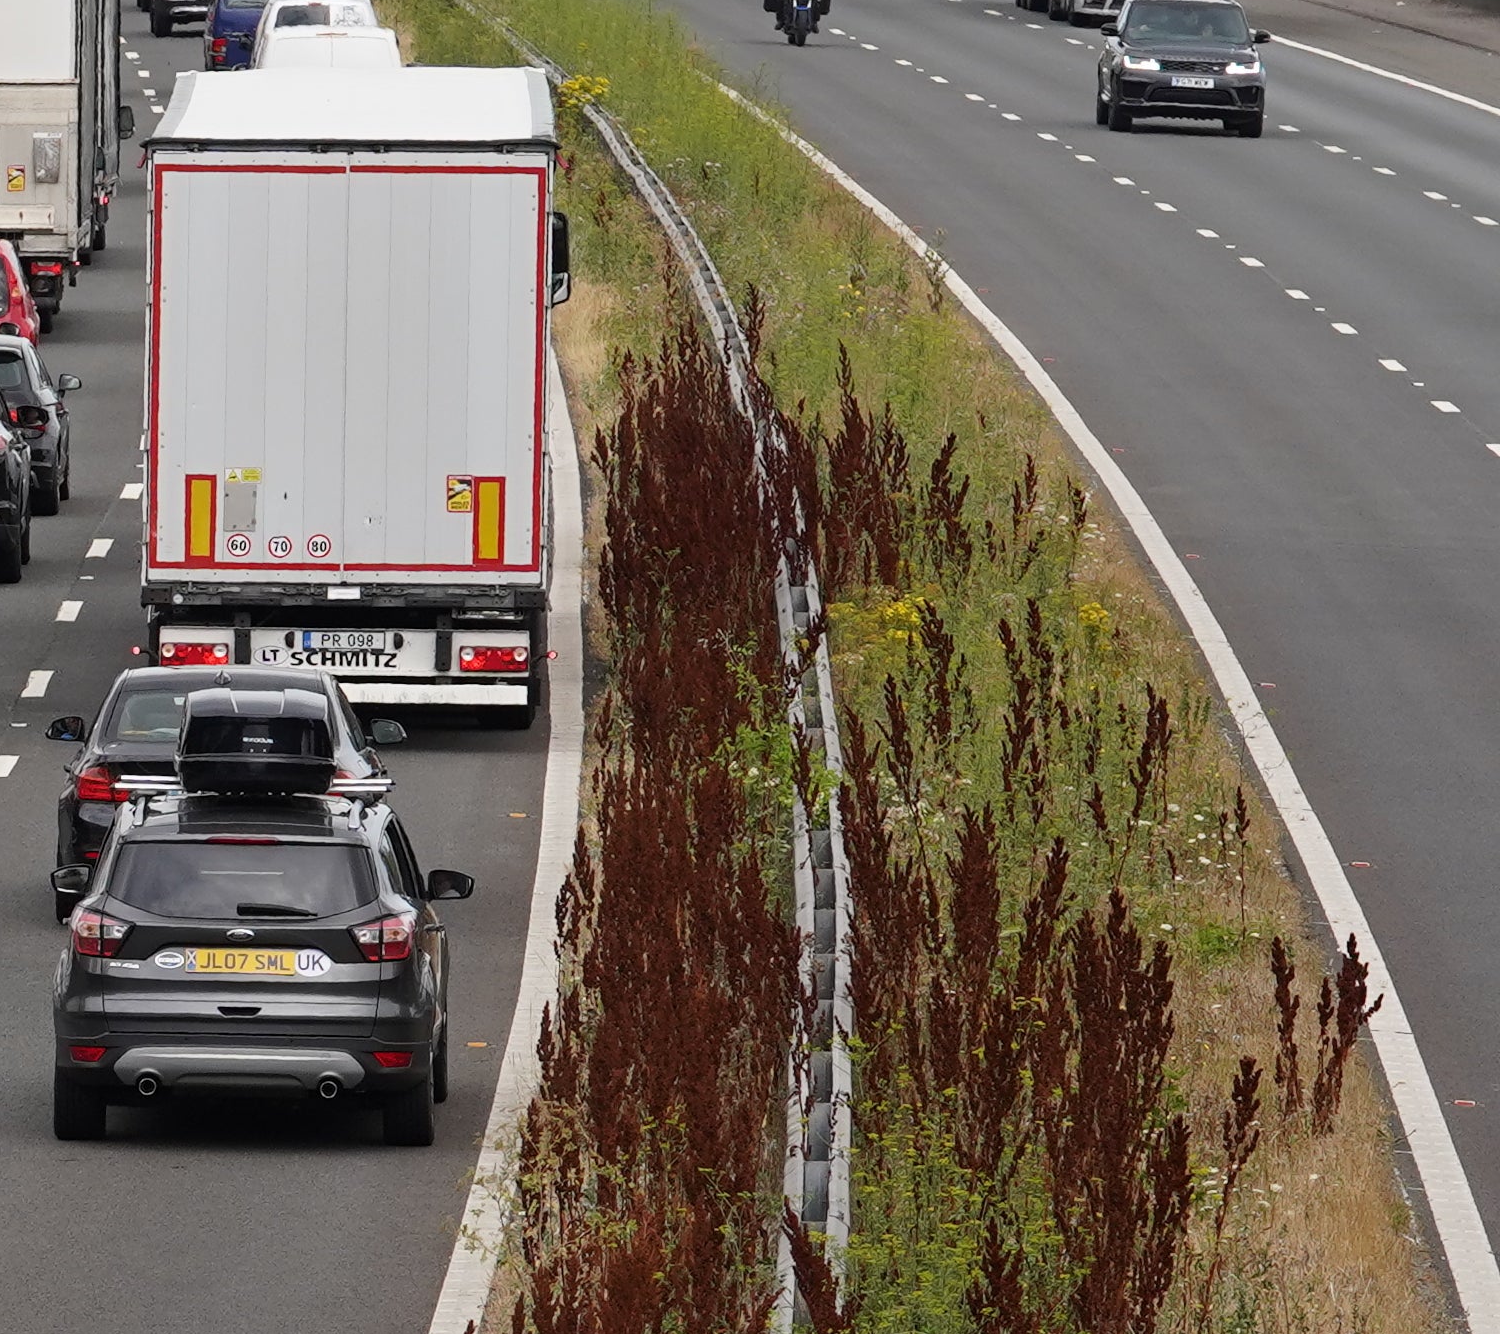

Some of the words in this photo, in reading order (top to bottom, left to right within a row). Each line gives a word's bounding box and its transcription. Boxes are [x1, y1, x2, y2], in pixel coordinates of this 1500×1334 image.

[231, 540, 247, 551] 60
[273, 541, 288, 552] 70
[311, 540, 327, 552] 80
[321, 634, 341, 648] PR
[348, 634, 374, 648] 098
[262, 649, 280, 662] LT
[290, 650, 399, 667] SCHMITZ
[200, 953, 248, 970] JL07
[255, 954, 291, 971] SML
[298, 953, 325, 971] UK
